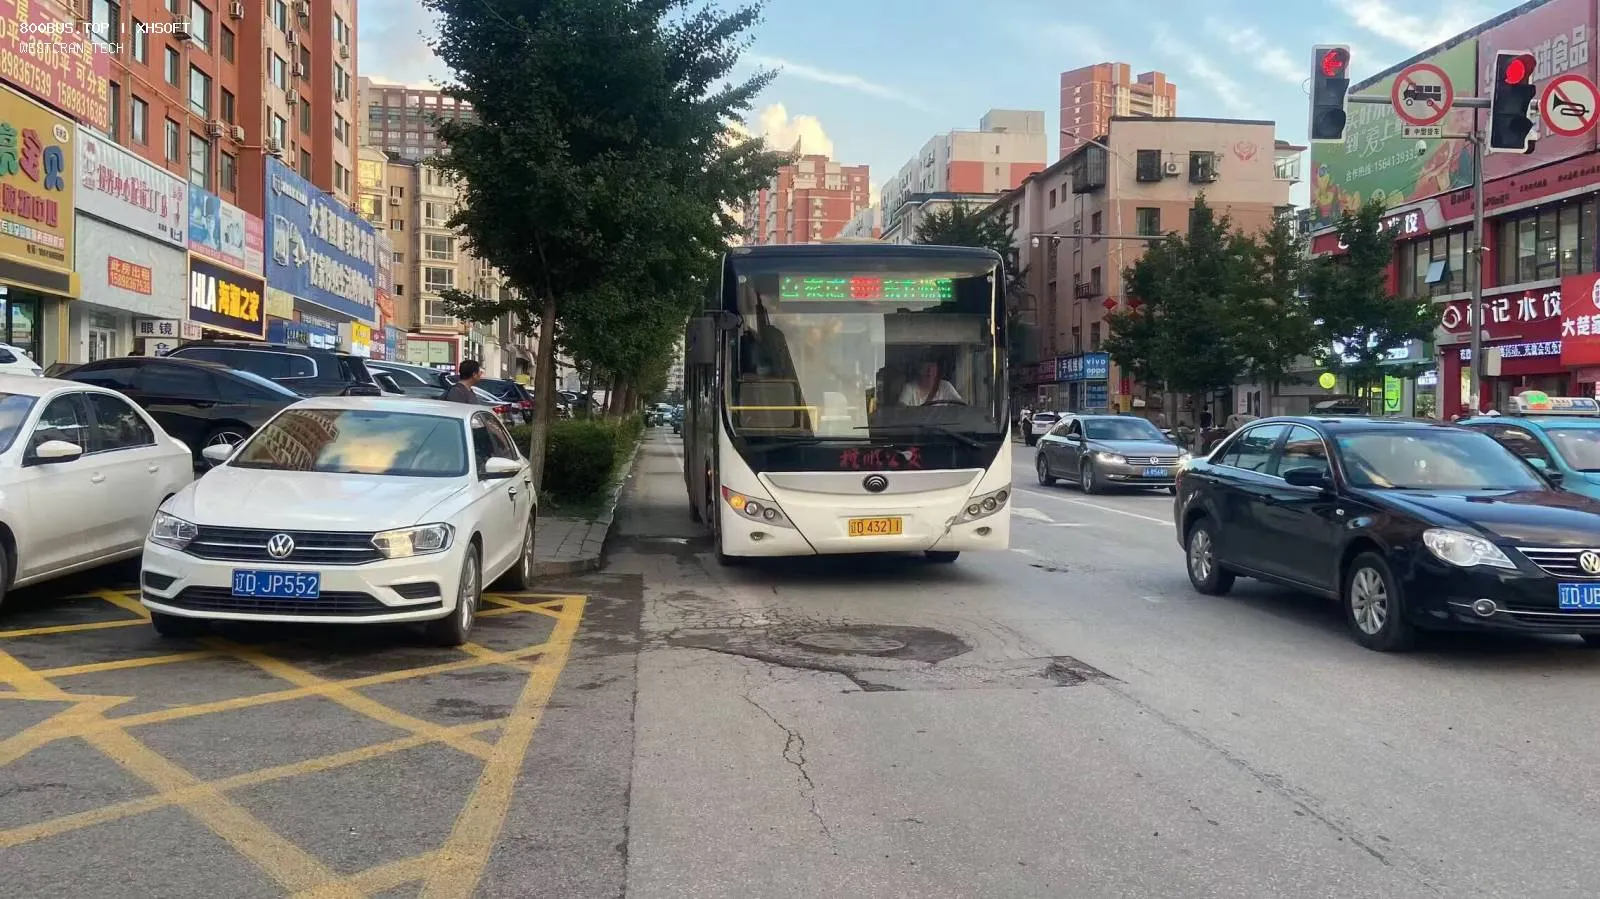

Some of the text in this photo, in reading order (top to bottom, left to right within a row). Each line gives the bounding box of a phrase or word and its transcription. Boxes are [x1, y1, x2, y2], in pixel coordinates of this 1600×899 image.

[191, 270, 217, 313] HLA
[1086, 357, 1107, 366] vivo
[1086, 366, 1107, 376] oppo
